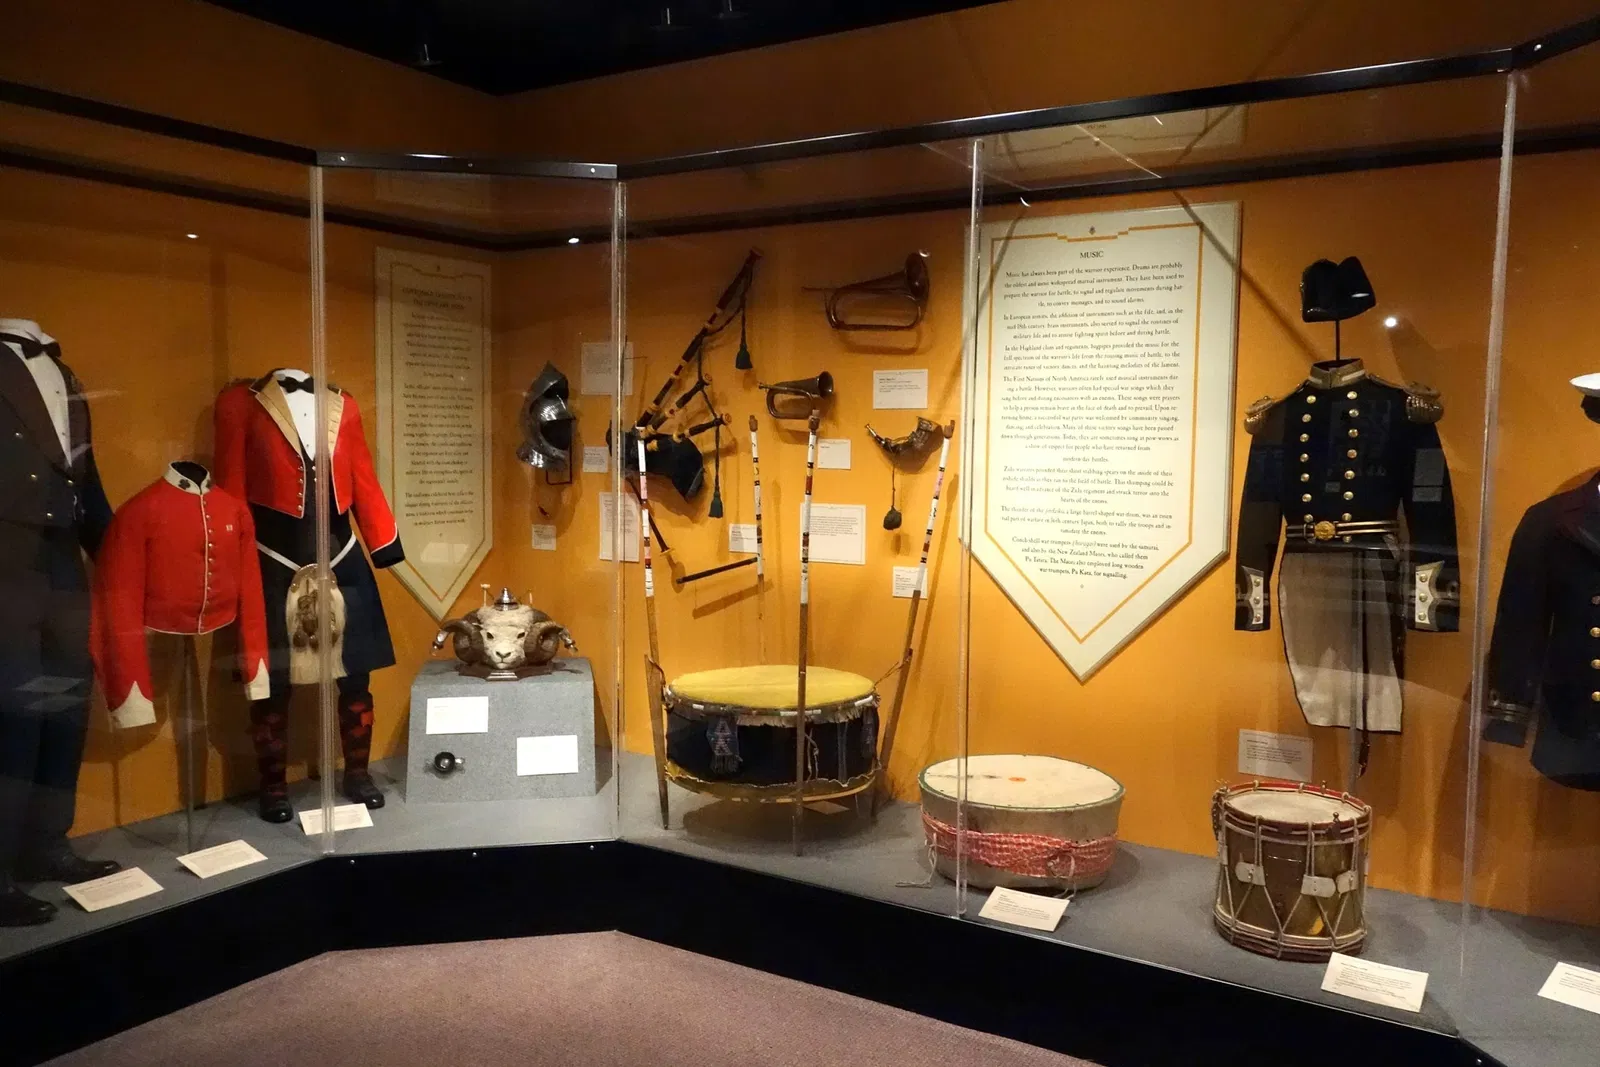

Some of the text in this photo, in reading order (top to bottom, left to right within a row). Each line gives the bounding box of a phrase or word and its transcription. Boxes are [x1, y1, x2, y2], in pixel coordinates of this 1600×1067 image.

[1058, 269, 1068, 277] part
[1125, 275, 1139, 284] They
[1162, 384, 1175, 393] they
[1154, 404, 1170, 413] Upon
[1111, 561, 1123, 570] long
